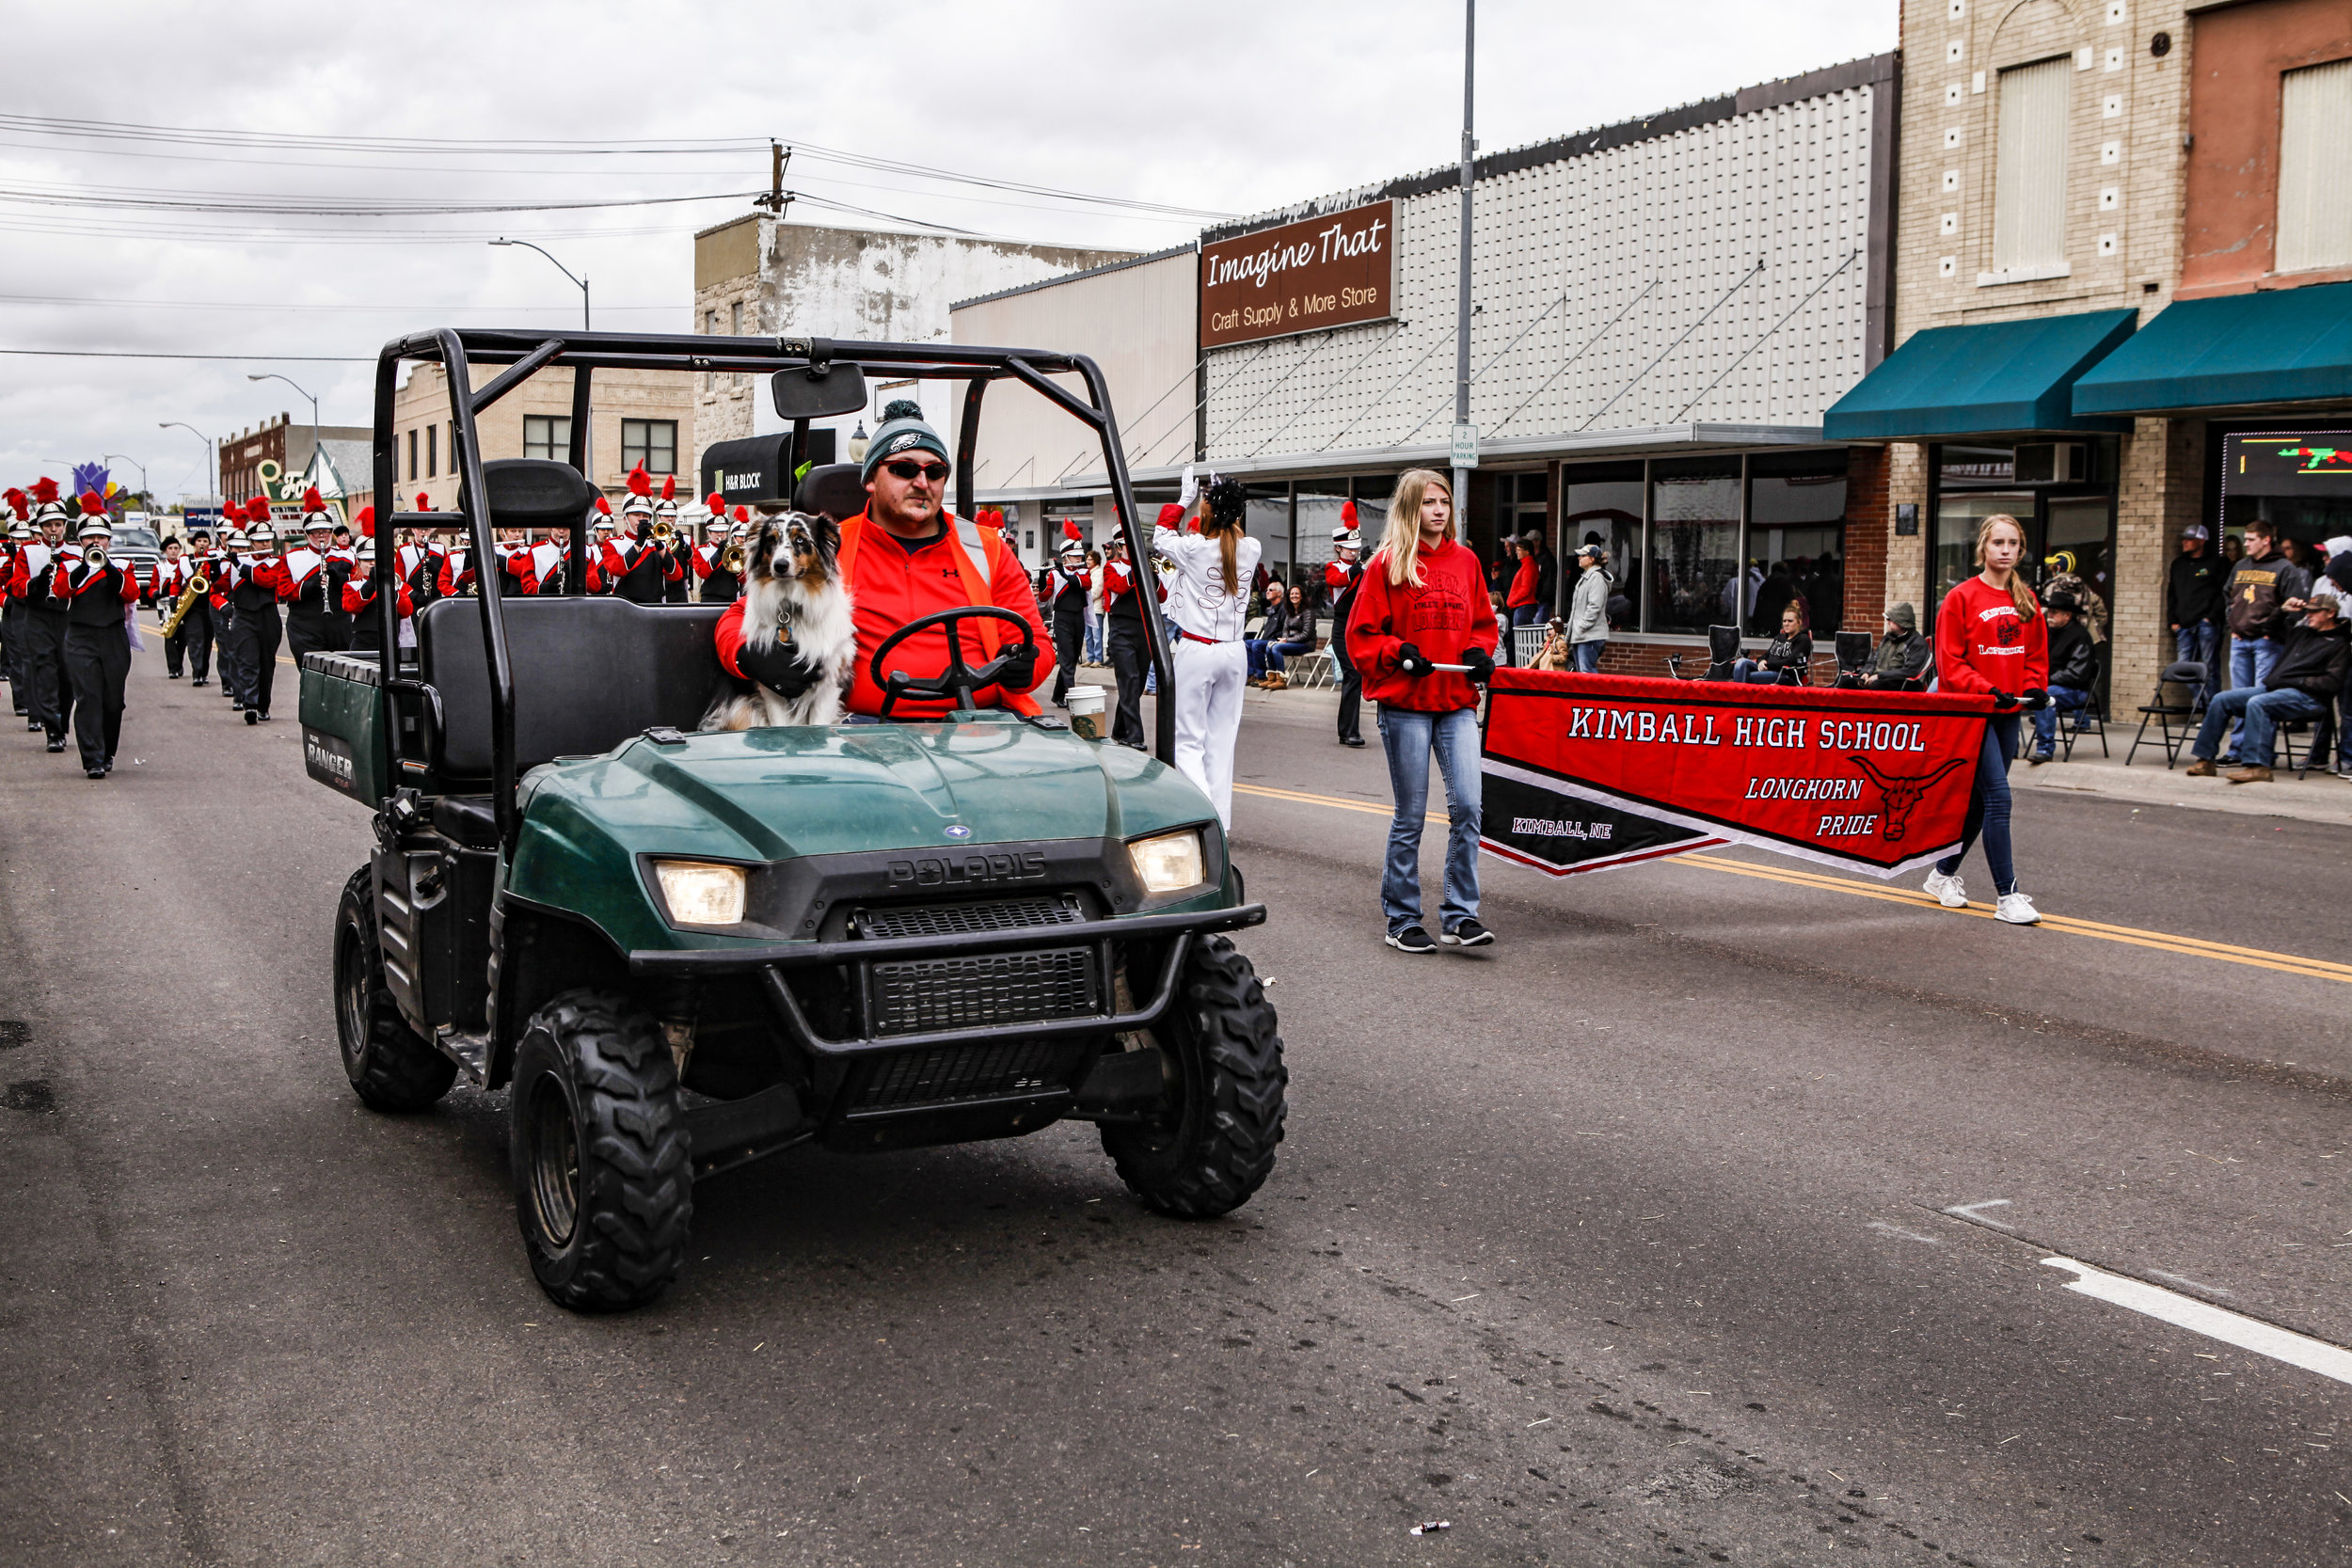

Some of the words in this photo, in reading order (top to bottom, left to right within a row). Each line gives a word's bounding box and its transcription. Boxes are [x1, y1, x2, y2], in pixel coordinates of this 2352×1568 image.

[1207, 242, 1316, 288] Imagine
[1319, 218, 1386, 264] That
[1212, 309, 1239, 331] Craft
[1244, 302, 1283, 327] Supply
[1289, 297, 1298, 317] &
[1304, 294, 1336, 315] More
[1342, 287, 1376, 309] Store
[1462, 431, 1468, 439] 2
[725, 475, 739, 490] H&R
[1568, 707, 1721, 746] KIMBALL
[1733, 717, 1807, 749] HIGH
[1819, 721, 1926, 752] SCHOOL
[308, 743, 353, 780] RANGER
[1744, 777, 1865, 800] LONGHORN
[1512, 817, 1588, 841] KIMBALL,
[1590, 823, 1613, 839] NE
[1816, 815, 1878, 836] PRIDE
[888, 851, 1046, 888] POLARIS
